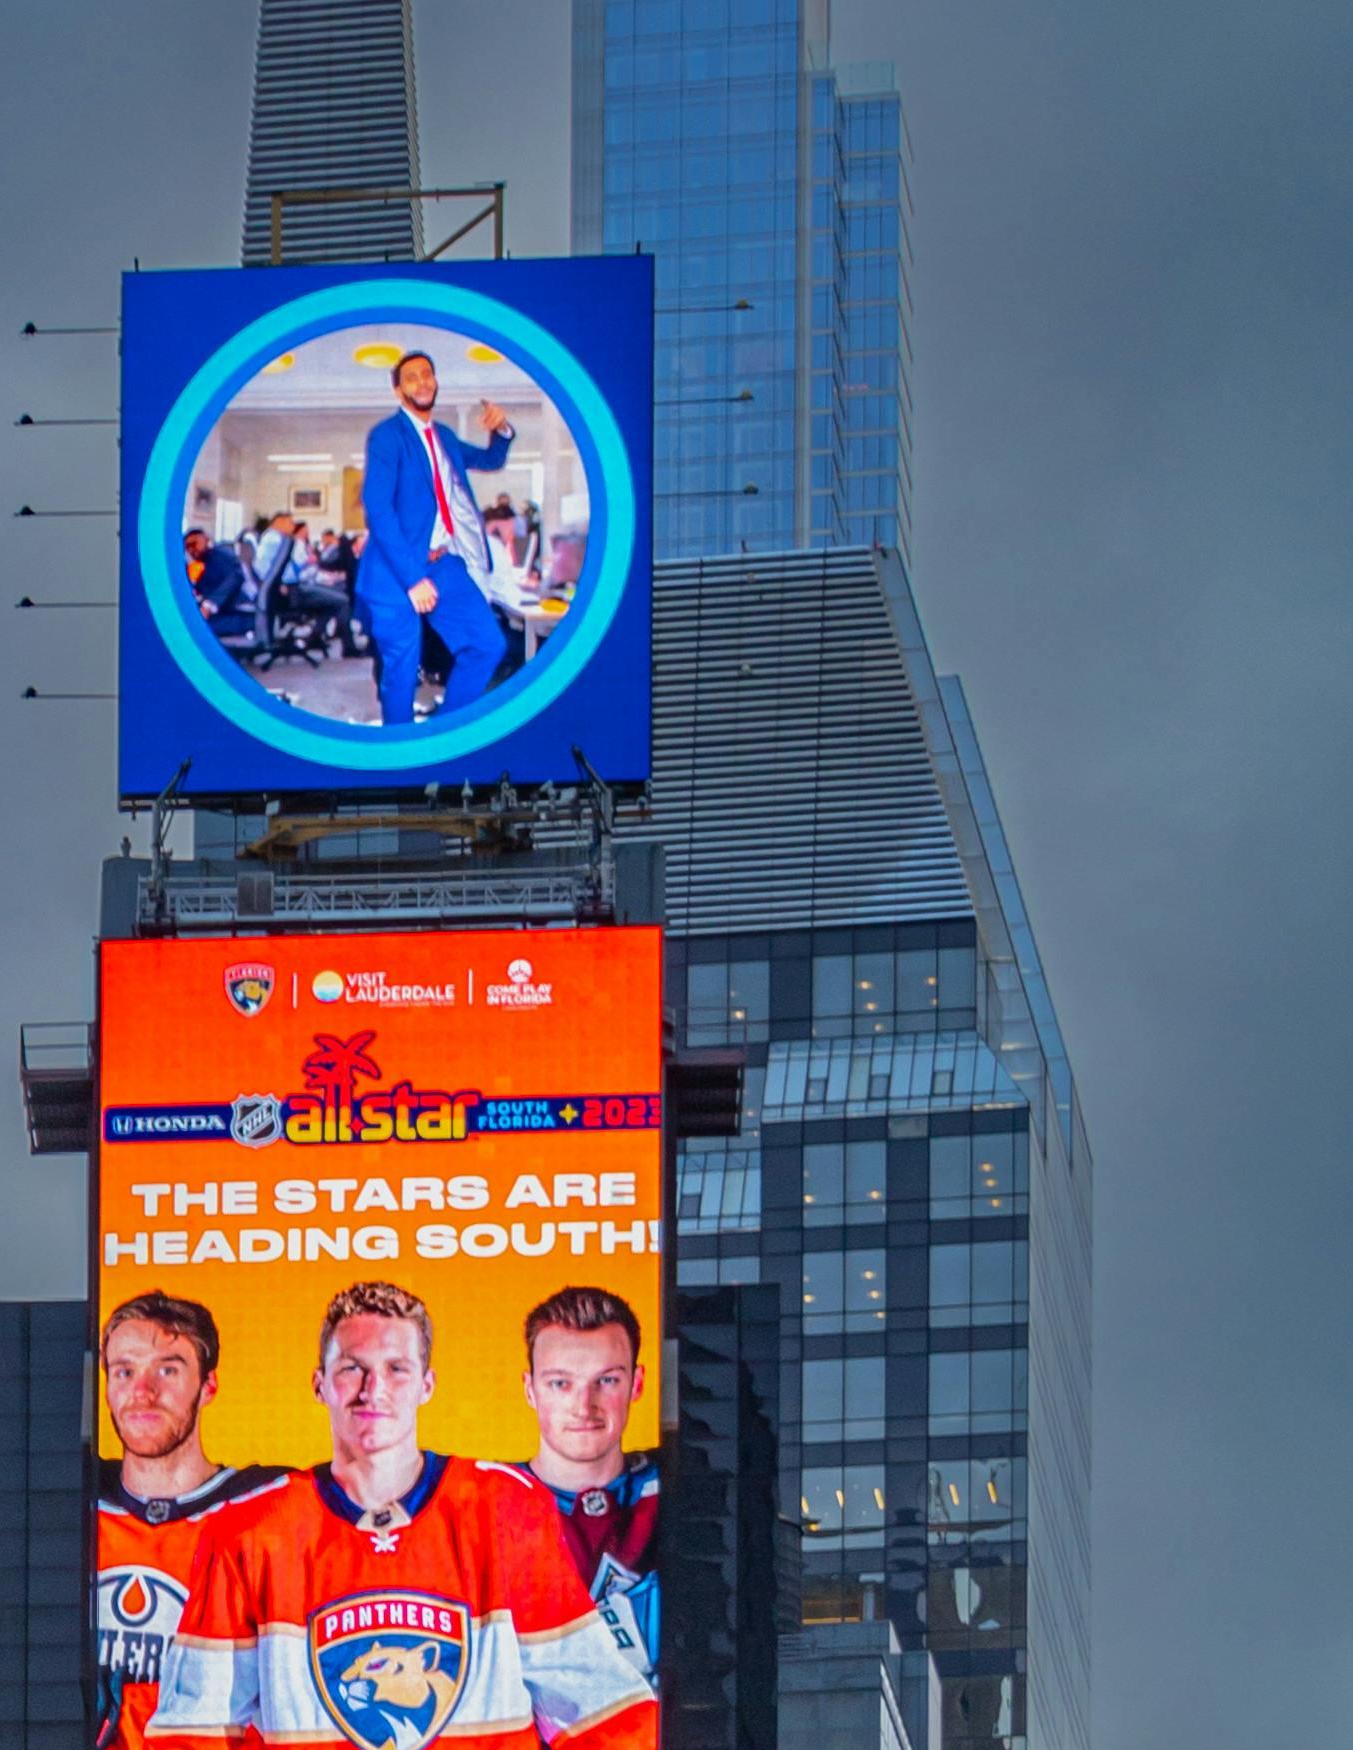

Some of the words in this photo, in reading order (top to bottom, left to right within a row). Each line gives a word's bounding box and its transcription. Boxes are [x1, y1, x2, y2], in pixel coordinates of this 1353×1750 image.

[345, 972, 387, 988] VISIT
[345, 985, 455, 1003] LAUDERDALE
[134, 1113, 226, 1133] HONDA
[241, 1104, 273, 1134] NHL
[486, 1101, 548, 1116] SOUTH
[478, 1114, 556, 1130] FLORIDA
[131, 1180, 258, 1217] THE
[274, 1174, 490, 1215] STARS
[505, 1172, 636, 1208] ARE
[104, 1226, 399, 1266] HEADING
[415, 1219, 662, 1259] SOUTH!
[325, 1607, 453, 1639] PANTHERS
